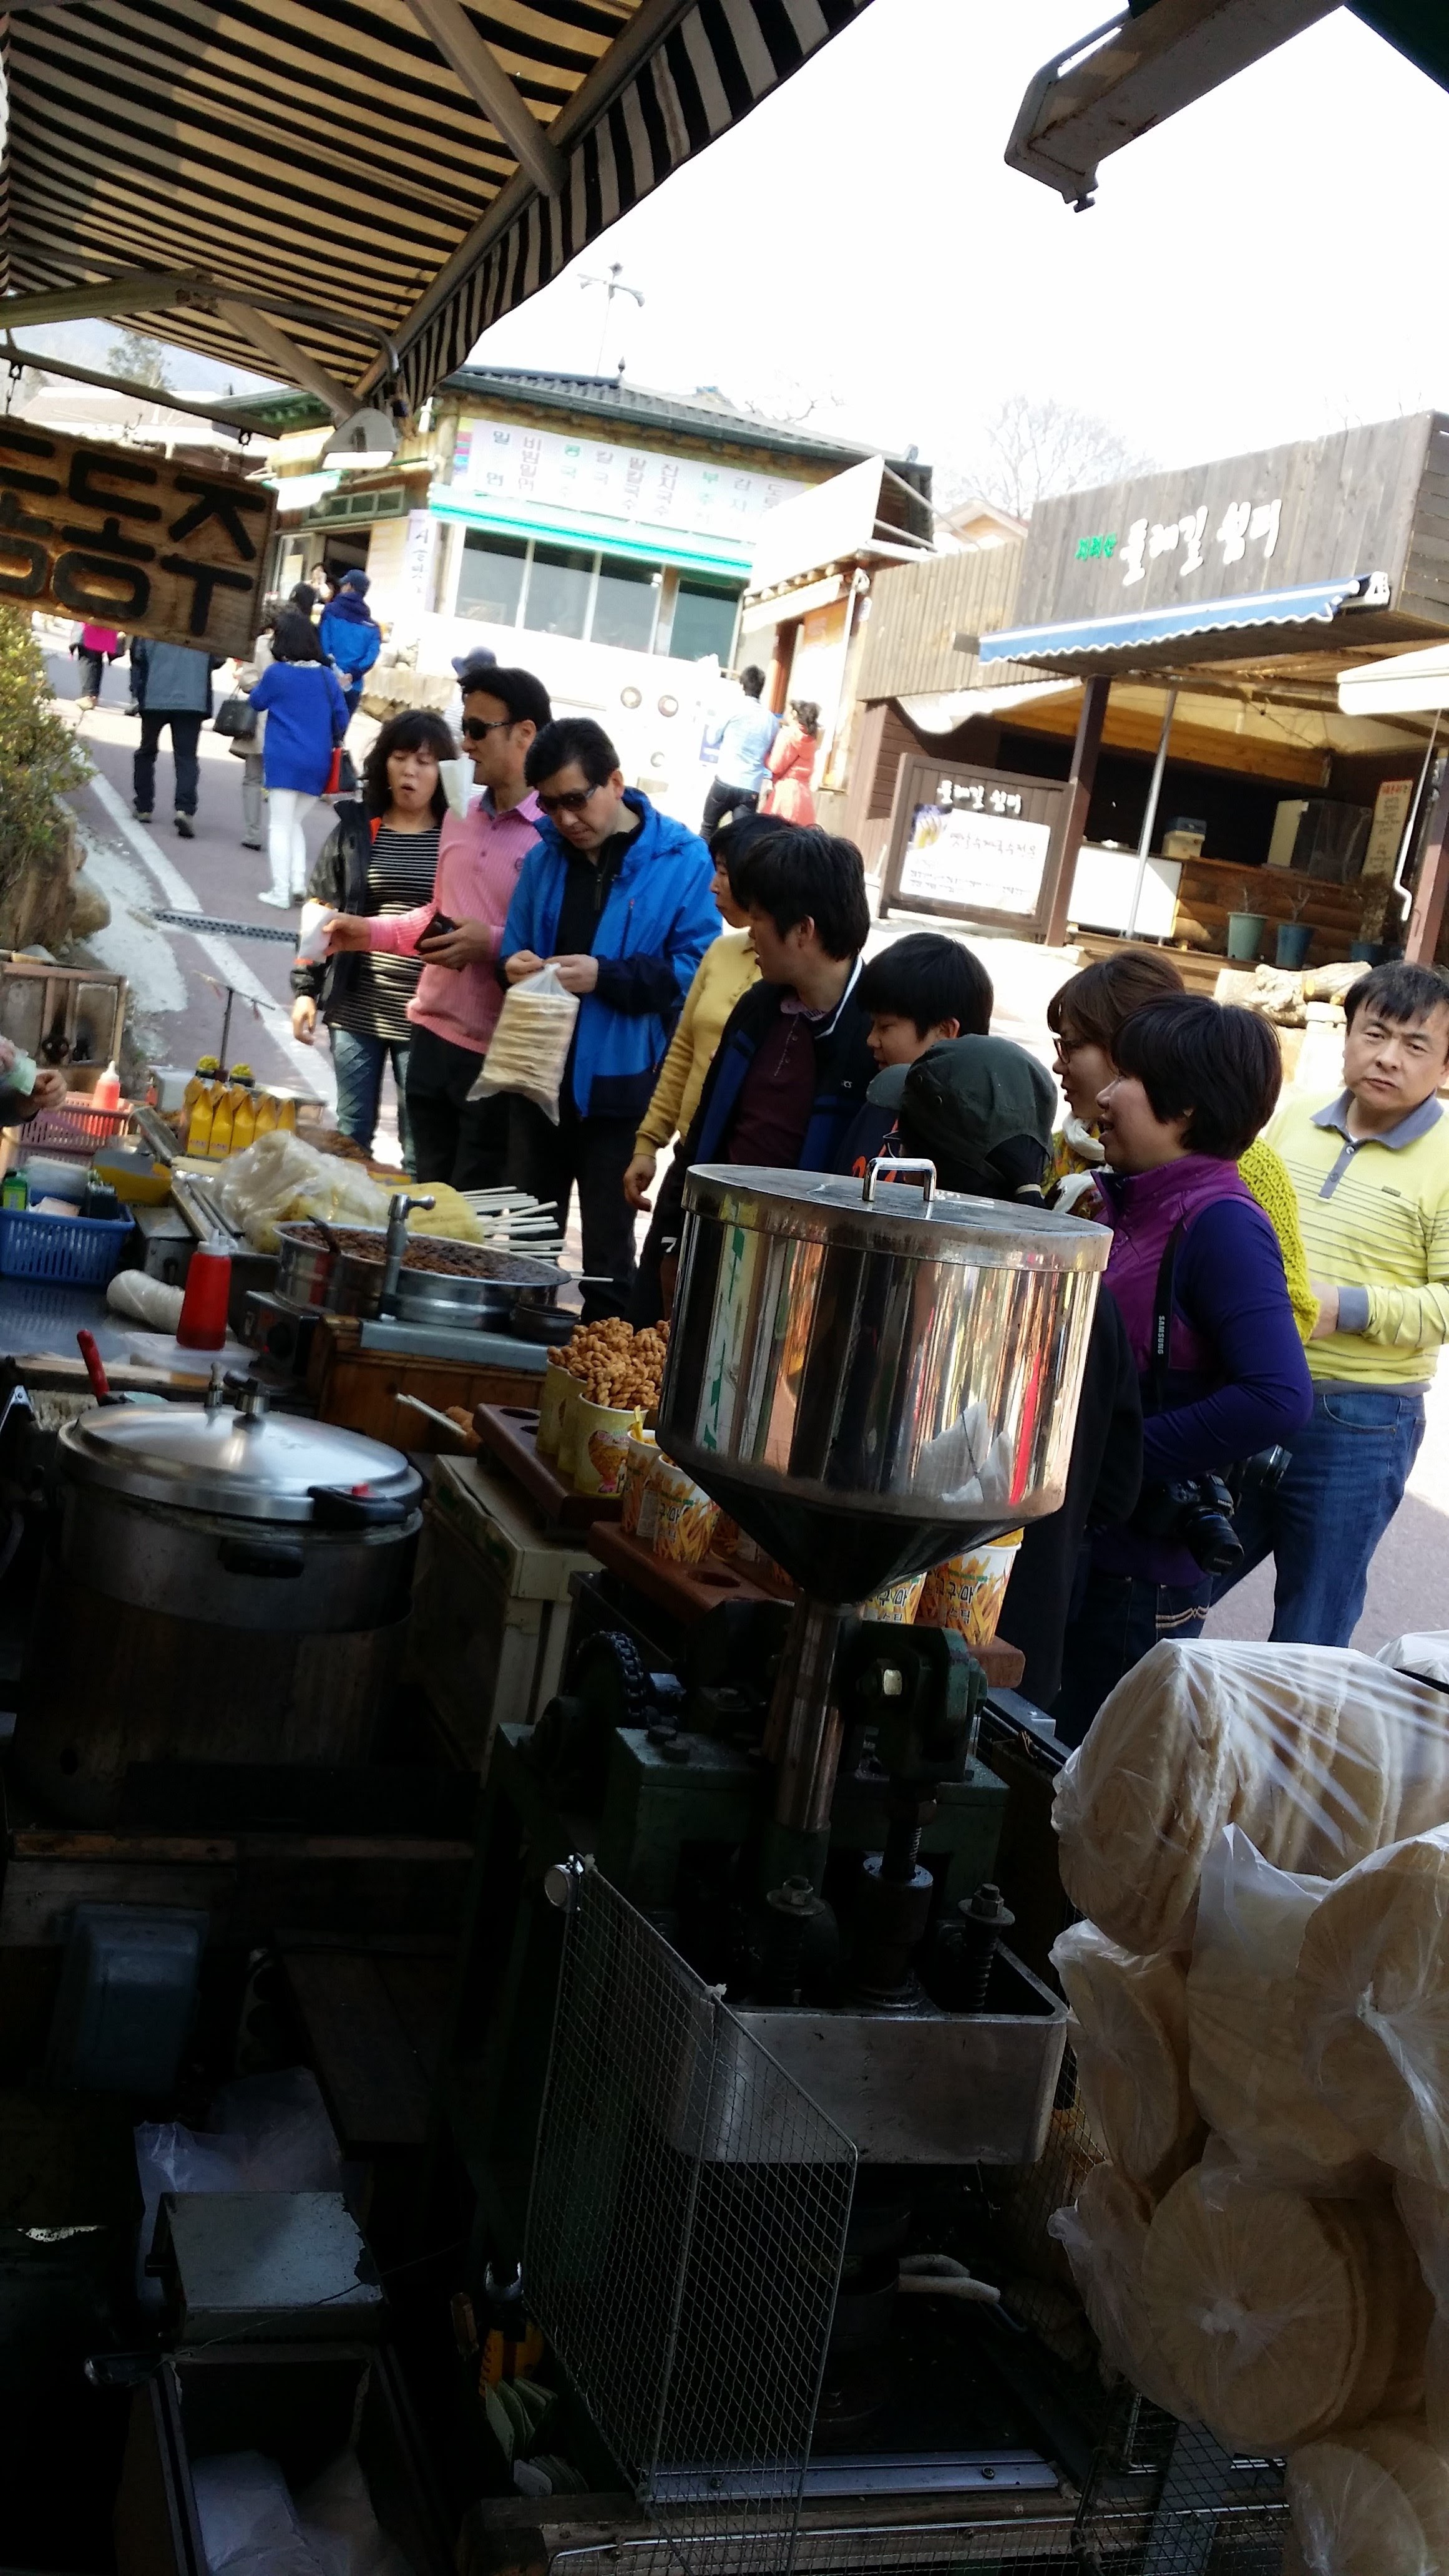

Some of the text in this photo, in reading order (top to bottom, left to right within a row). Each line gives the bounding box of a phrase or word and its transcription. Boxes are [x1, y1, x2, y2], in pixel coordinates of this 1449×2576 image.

[1217, 499, 1282, 564] 쉼터
[990, 789, 1022, 814] 쉼터
[876, 1588, 908, 1608] 구마
